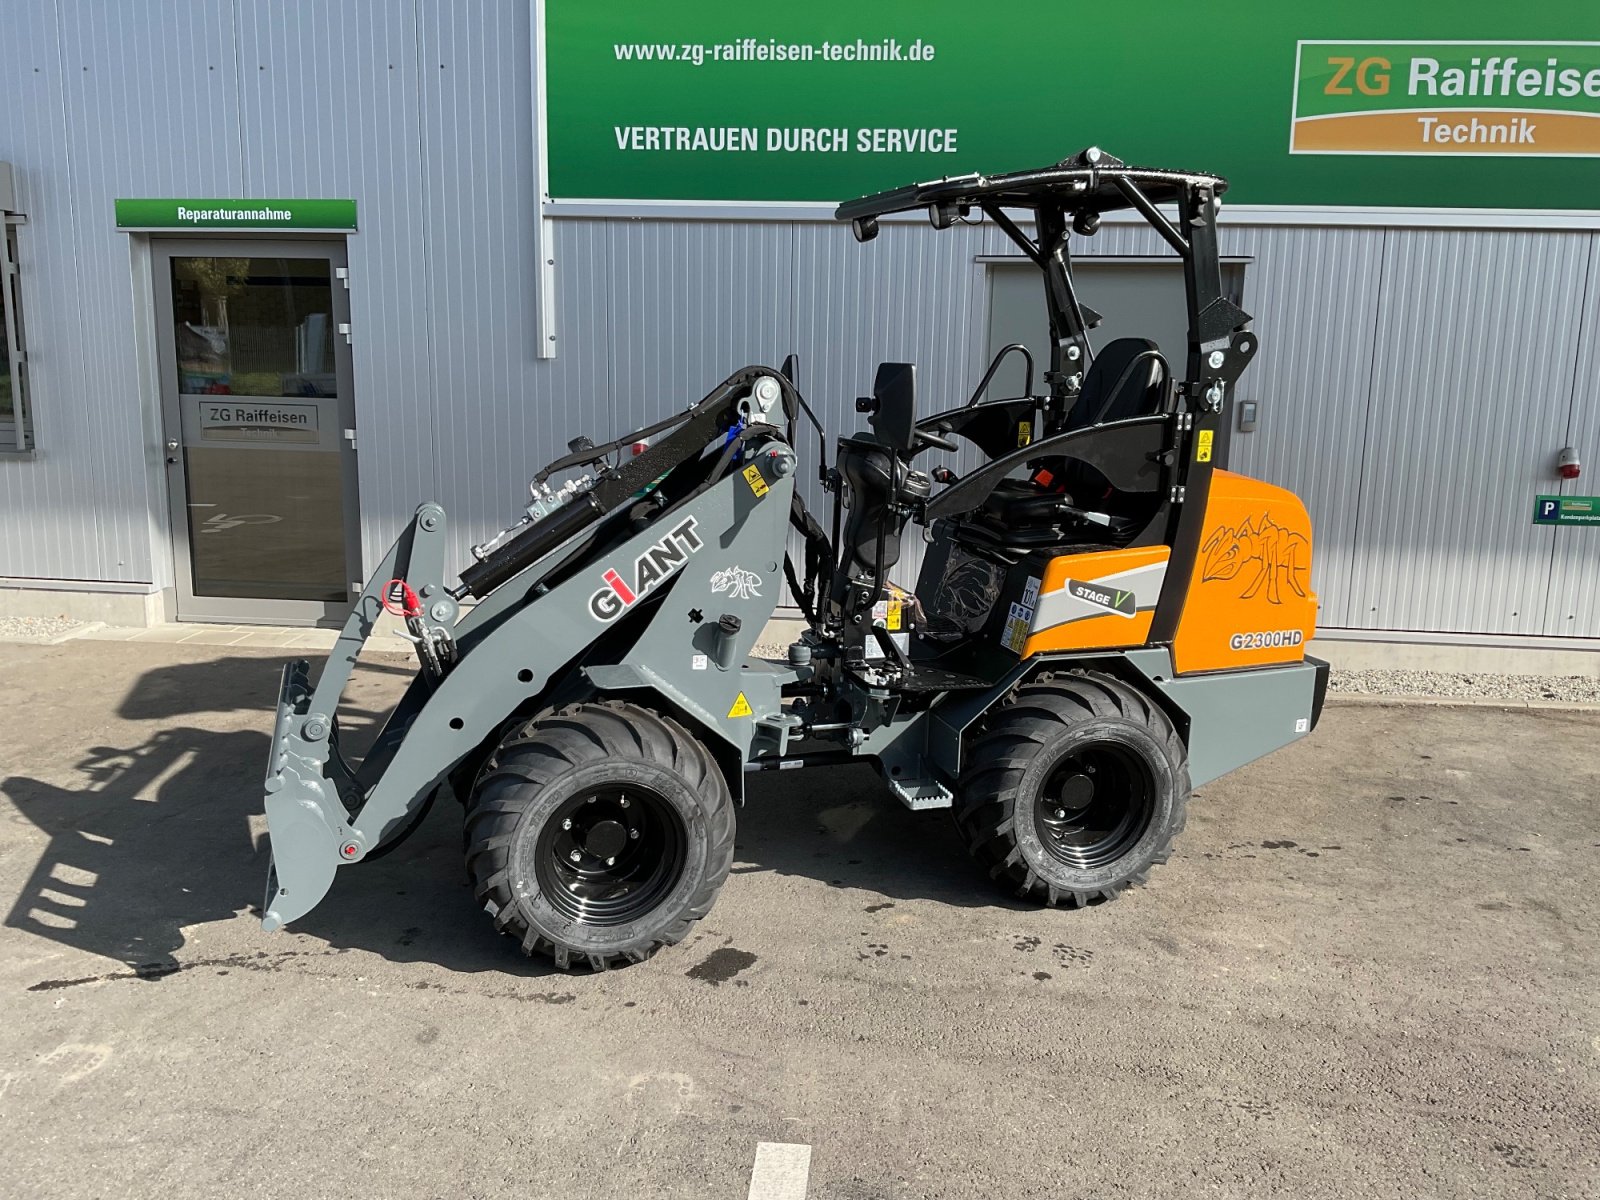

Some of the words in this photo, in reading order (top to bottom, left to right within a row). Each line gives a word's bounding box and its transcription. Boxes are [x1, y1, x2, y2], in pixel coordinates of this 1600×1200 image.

[614, 39, 935, 66] www.zg-raiffeisen-technik.de
[1324, 57, 1392, 96] ZG
[614, 126, 758, 151] VERTRAUEN
[766, 128, 849, 152] DURCH
[856, 129, 958, 153] SERVICE
[1417, 117, 1537, 144] Technik
[177, 206, 292, 223] Reparaturannahme
[210, 408, 231, 422] ZG
[235, 409, 307, 424] Raiffeisen
[1544, 501, 1555, 515] P
[1076, 586, 1111, 606] STAGE
[1114, 590, 1134, 609] V
[1230, 629, 1303, 651] G2300HD
